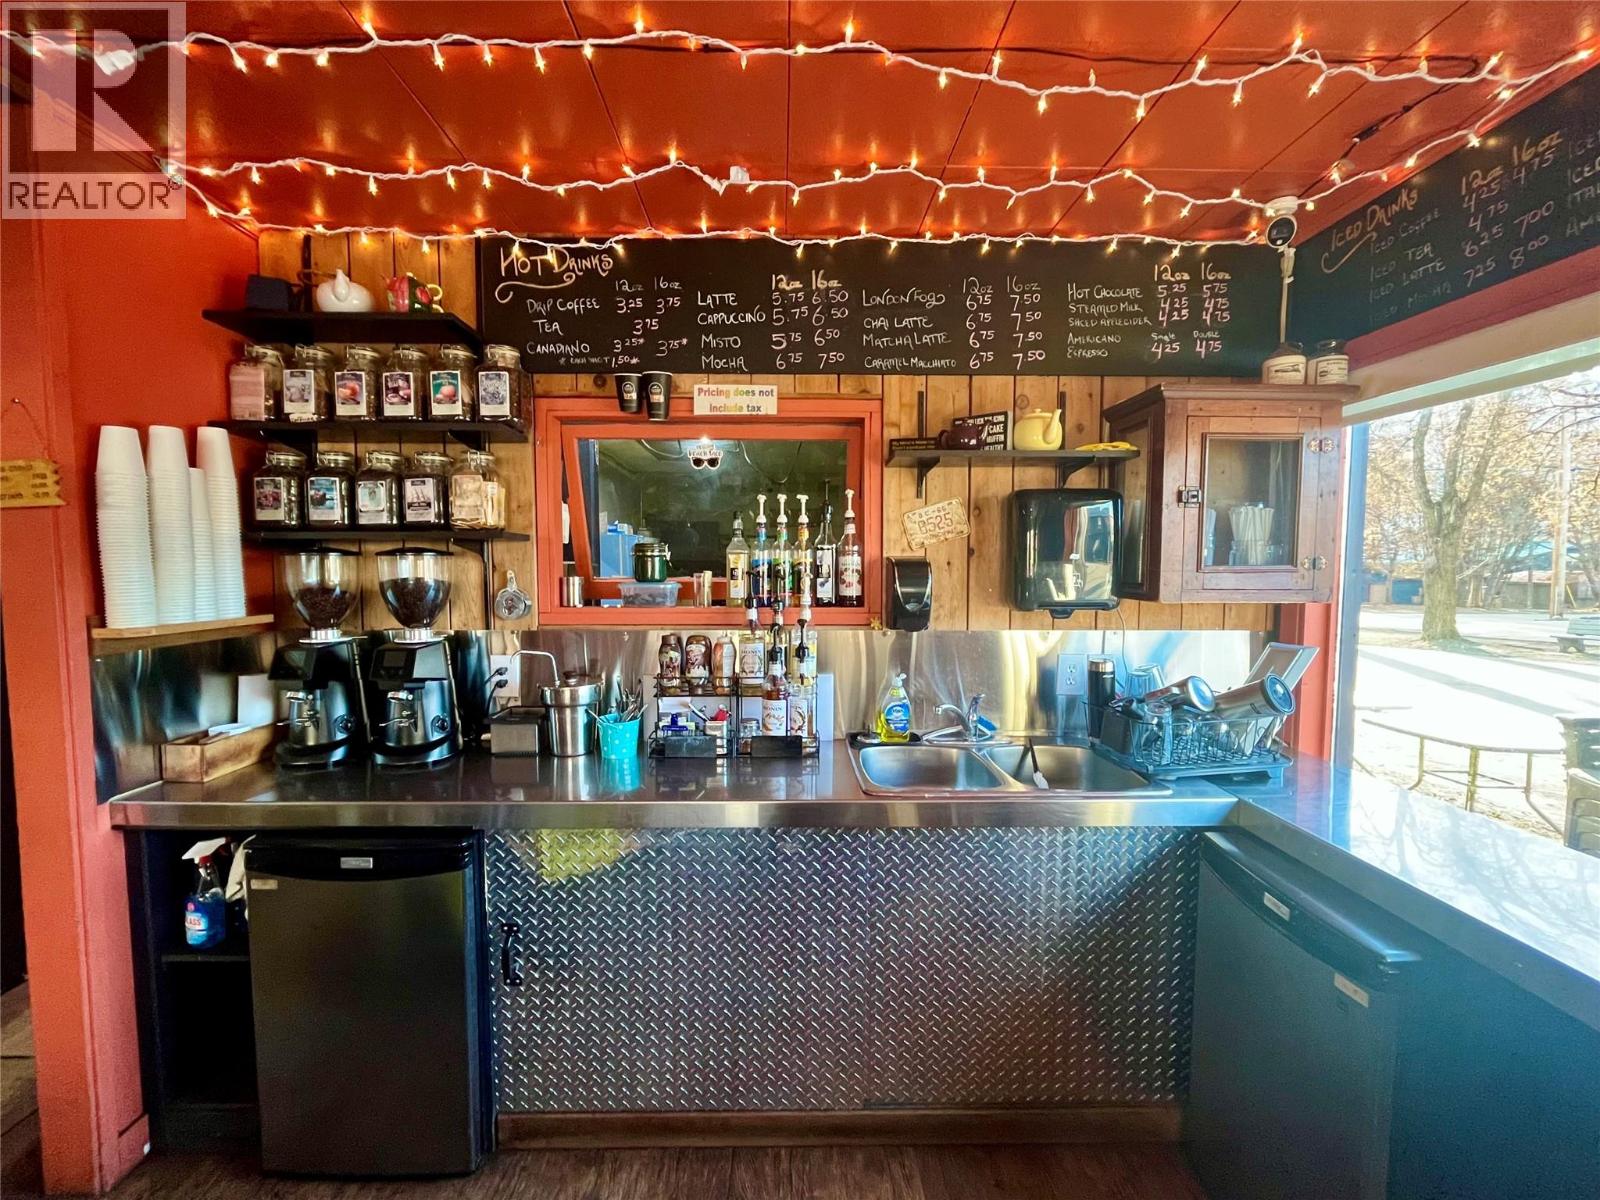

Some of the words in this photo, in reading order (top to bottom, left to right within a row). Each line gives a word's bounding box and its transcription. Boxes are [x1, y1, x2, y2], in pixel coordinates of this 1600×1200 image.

[1331, 221, 1362, 252] ICED
[1404, 242, 1434, 261] TEA
[501, 247, 547, 276] HOT
[1402, 257, 1446, 286] LATTE
[697, 291, 738, 308] LATTE
[862, 287, 916, 307] LONDON
[1067, 282, 1091, 302] HOT
[1093, 284, 1143, 299] CHOCOLATE
[697, 305, 767, 325] CAPPUCCINO
[1119, 302, 1143, 313] MILK
[532, 319, 564, 336] TEA
[864, 317, 889, 331] CHAI
[895, 317, 934, 329] LATTE
[701, 333, 741, 349] MISTO
[863, 333, 914, 350] MATCHA
[913, 332, 952, 346] LATTE
[1067, 332, 1121, 345] AMERICANO
[527, 340, 590, 357] CANADIANO
[702, 354, 749, 372] MOCHA
[864, 355, 909, 372] CARAMEL
[697, 387, 731, 400] Pricing
[733, 387, 755, 398] does
[758, 388, 774, 398] not
[746, 403, 762, 413] tax
[989, 424, 1005, 434] CAKE
